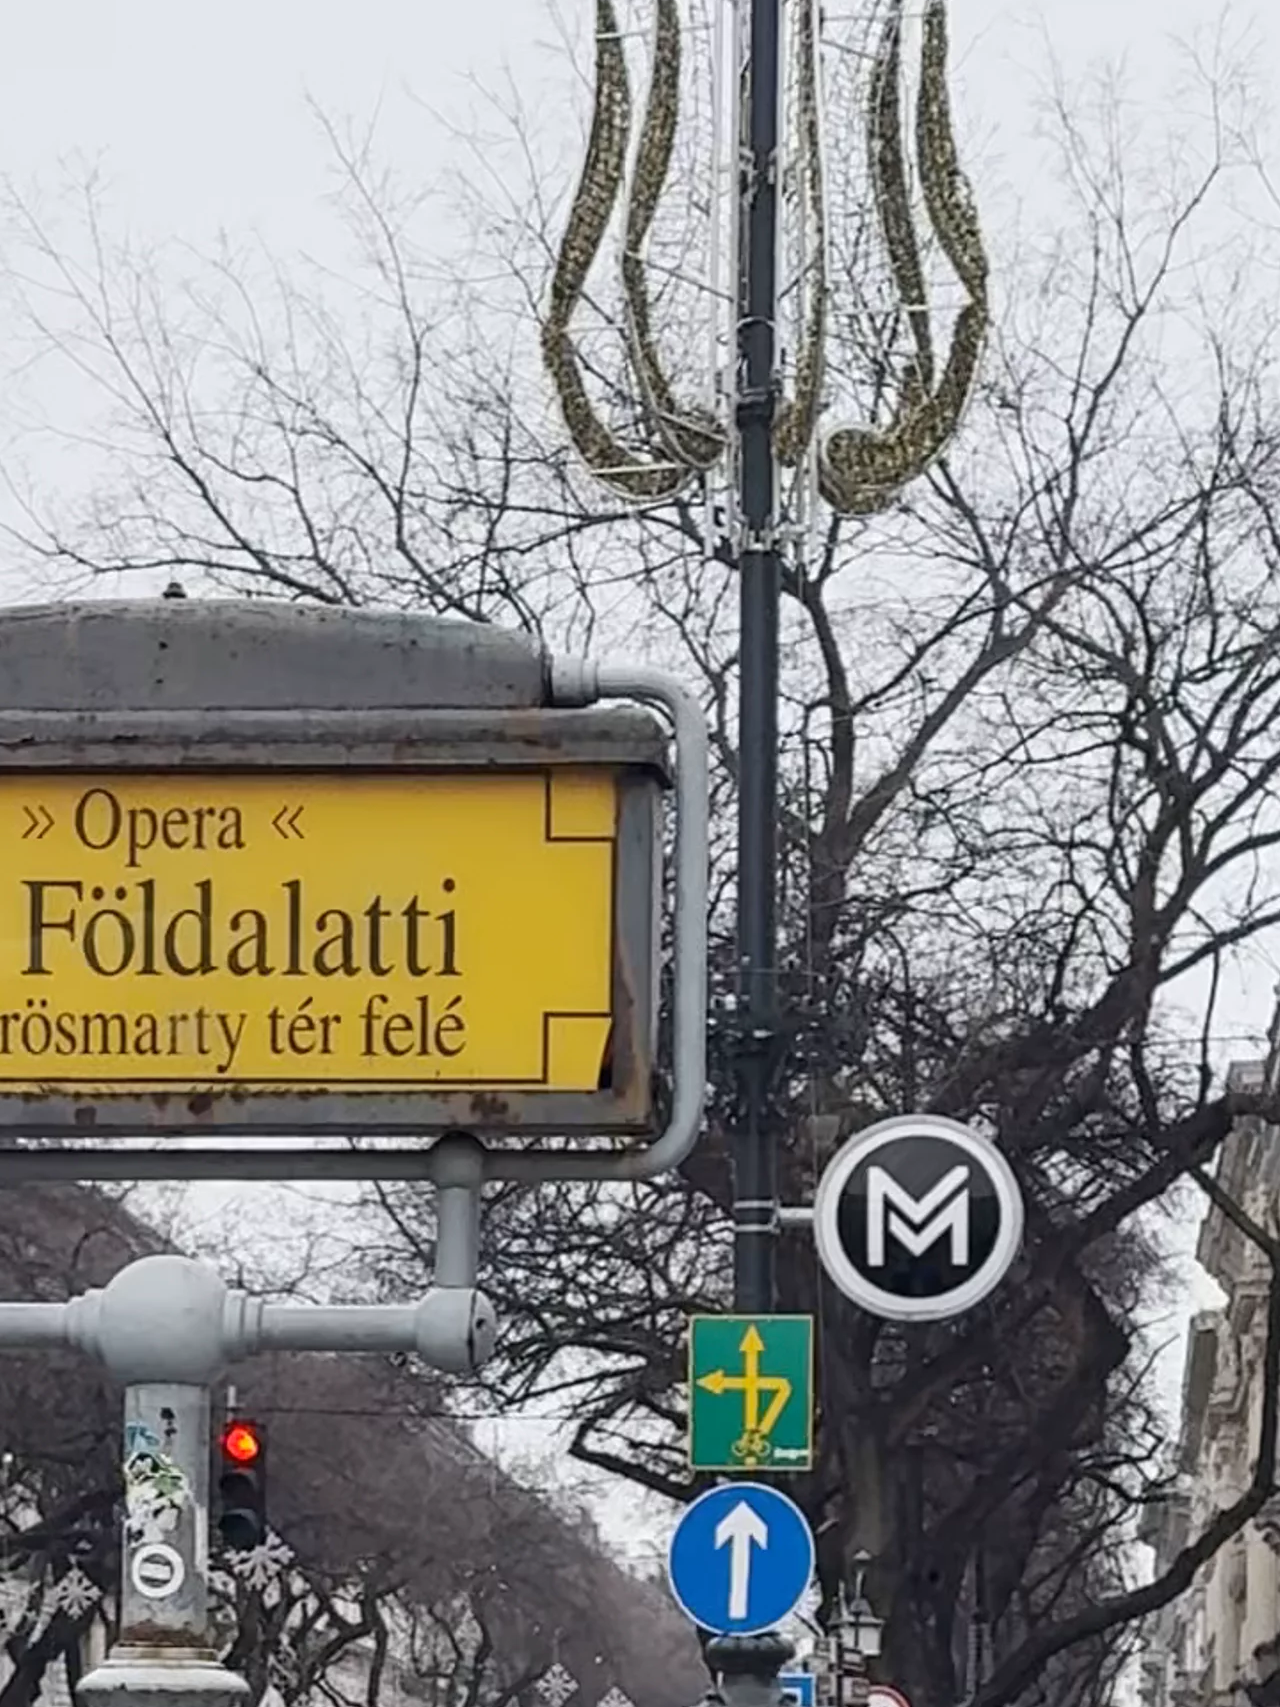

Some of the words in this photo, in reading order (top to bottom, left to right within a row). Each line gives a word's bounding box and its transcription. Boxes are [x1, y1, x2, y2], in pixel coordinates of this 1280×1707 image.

[74, 787, 247, 868] Opera
[19, 877, 464, 978] Földalatti
[268, 996, 342, 1056] tér
[359, 993, 467, 1058] felé
